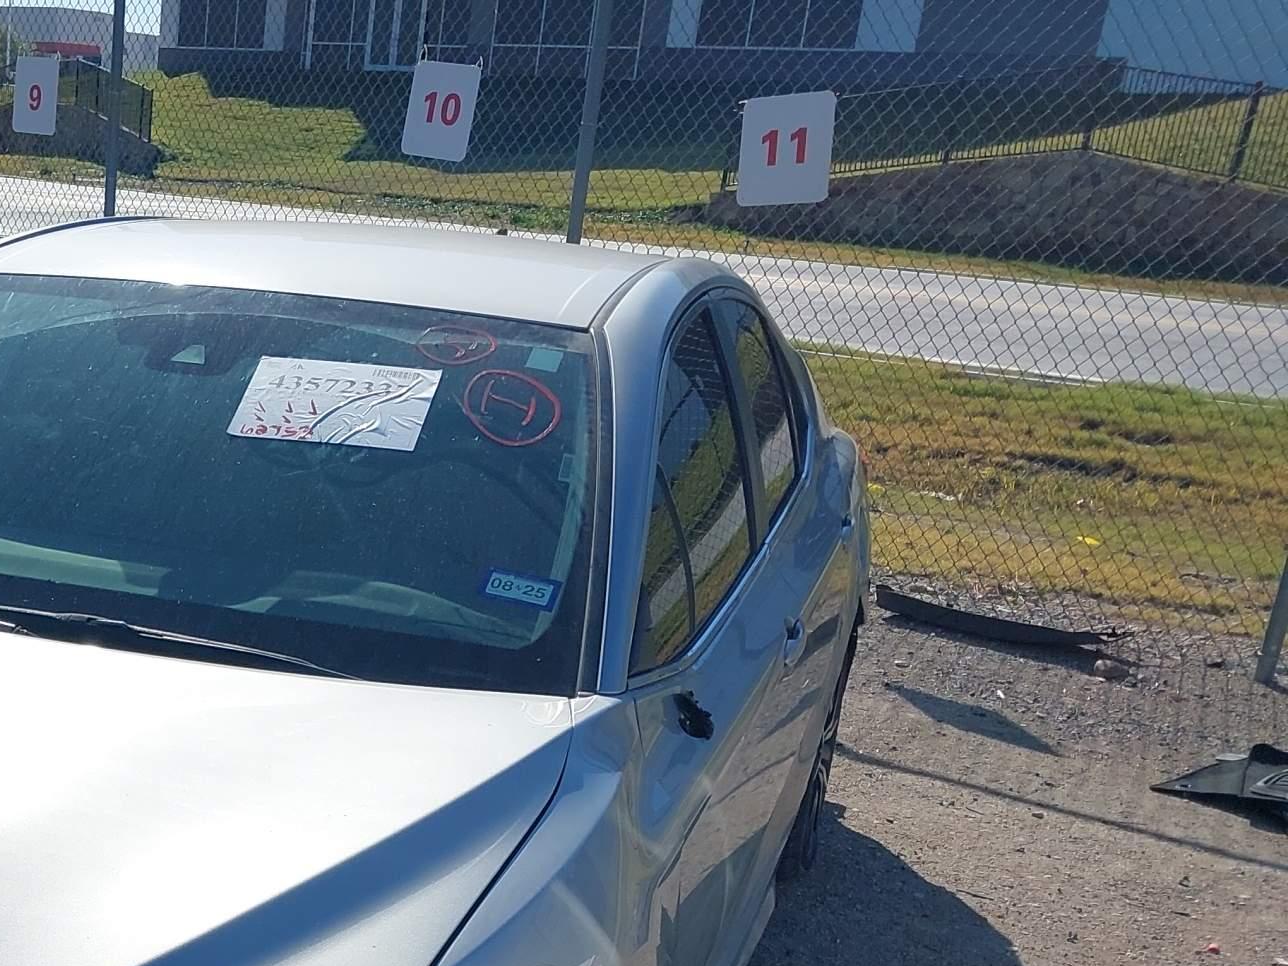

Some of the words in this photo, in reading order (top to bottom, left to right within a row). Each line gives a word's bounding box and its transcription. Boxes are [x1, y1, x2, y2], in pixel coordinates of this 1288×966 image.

[29, 84, 42, 111] 9
[423, 91, 461, 126] 10
[761, 127, 808, 166] 11
